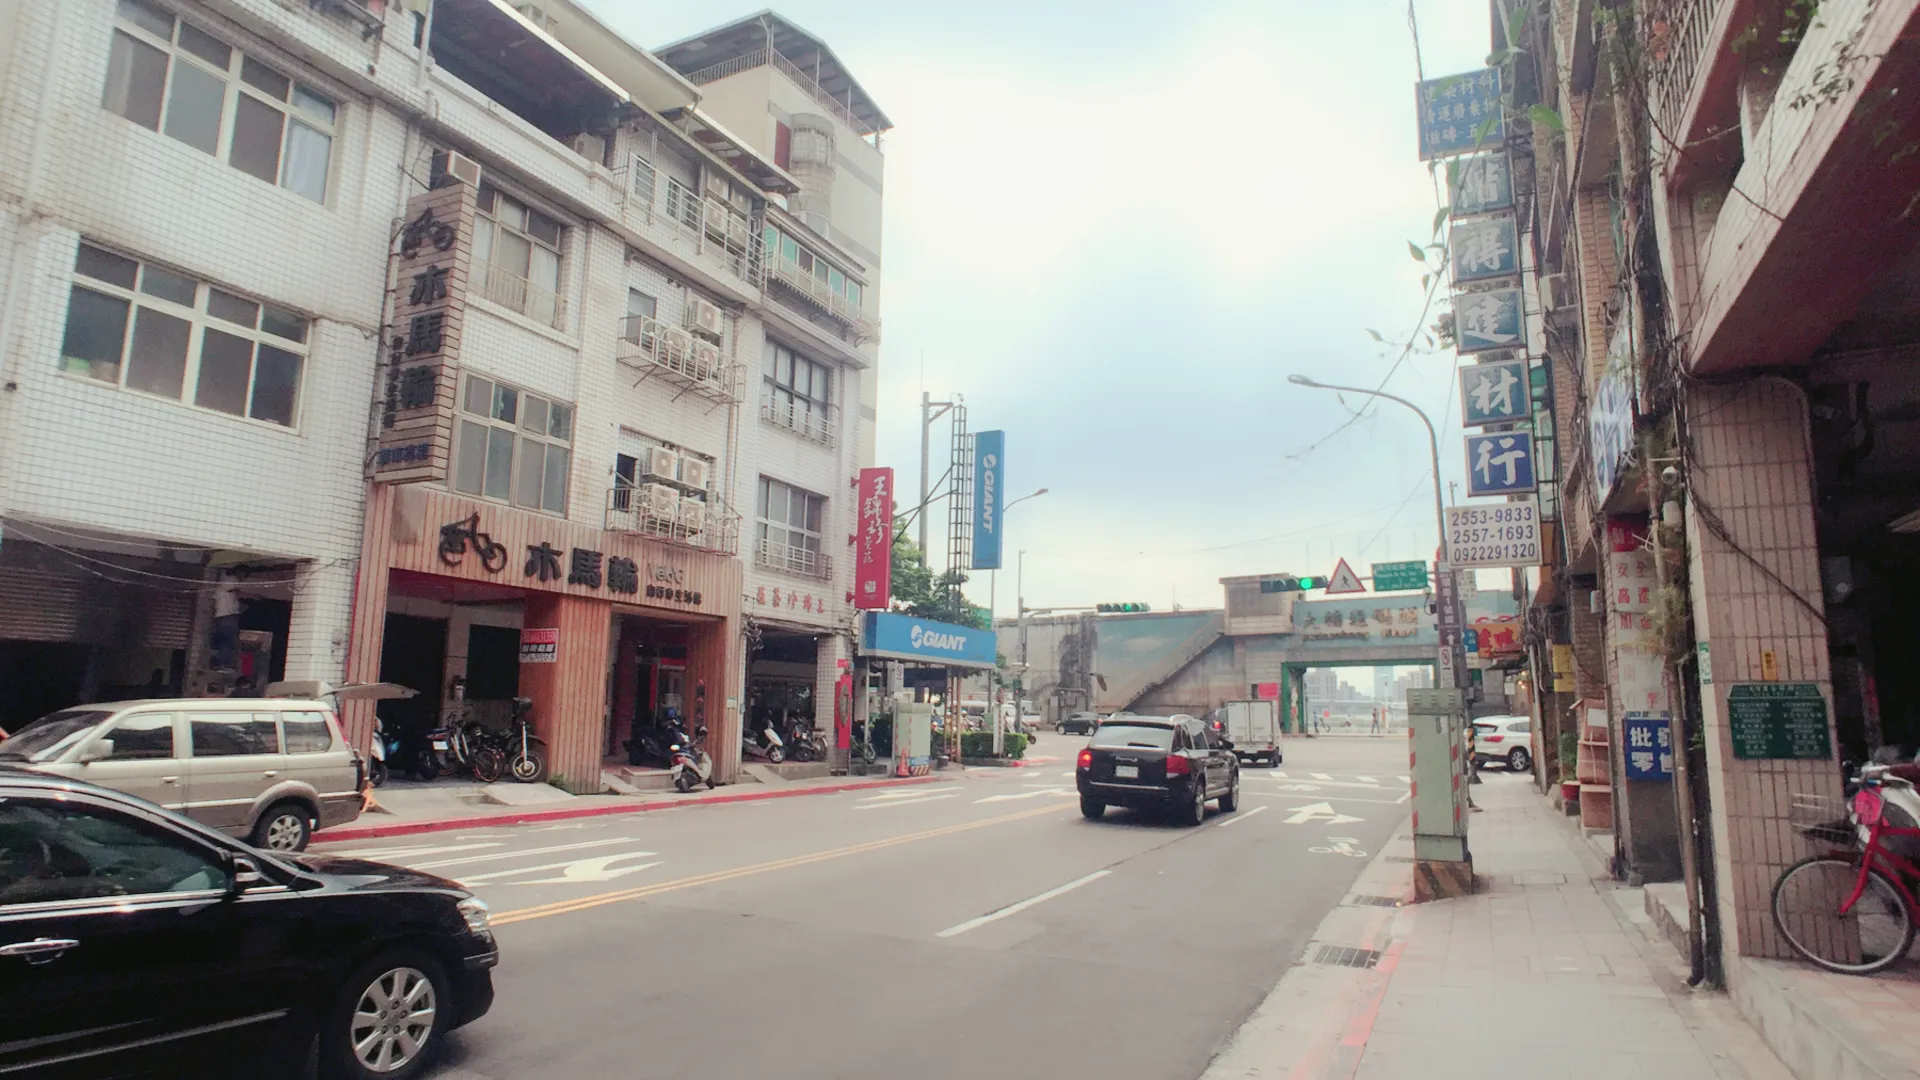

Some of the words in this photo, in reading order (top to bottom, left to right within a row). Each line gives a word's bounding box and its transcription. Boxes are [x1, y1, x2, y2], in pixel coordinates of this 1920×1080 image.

[401, 265, 449, 408] 木馬輪
[983, 470, 994, 534] GIANT
[1452, 507, 1532, 526] 2553-9833
[1453, 525, 1534, 544] 2557-1693
[1454, 543, 1535, 562] 0922291320
[524, 541, 638, 594] 木馬輪
[923, 630, 966, 652] GIANT
